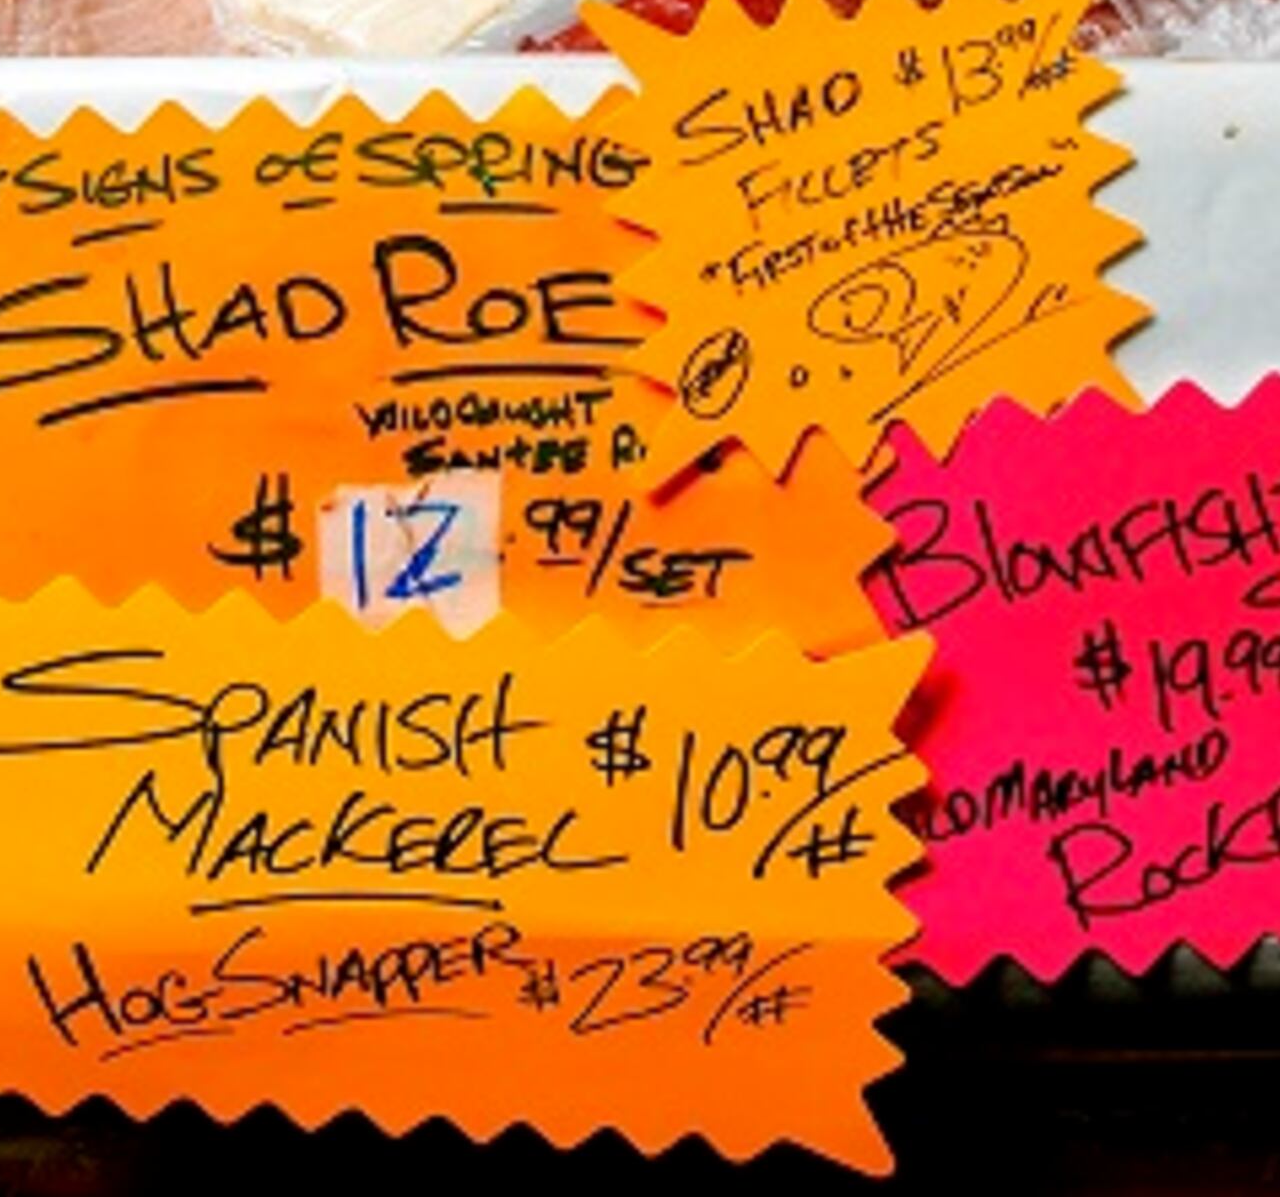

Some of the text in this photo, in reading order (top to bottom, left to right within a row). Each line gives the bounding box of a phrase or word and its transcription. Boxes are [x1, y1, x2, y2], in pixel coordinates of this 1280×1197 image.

[673, 68, 862, 169] SHAD
[372, 234, 646, 349] ROE
[84, 769, 630, 884] MACKEREL
